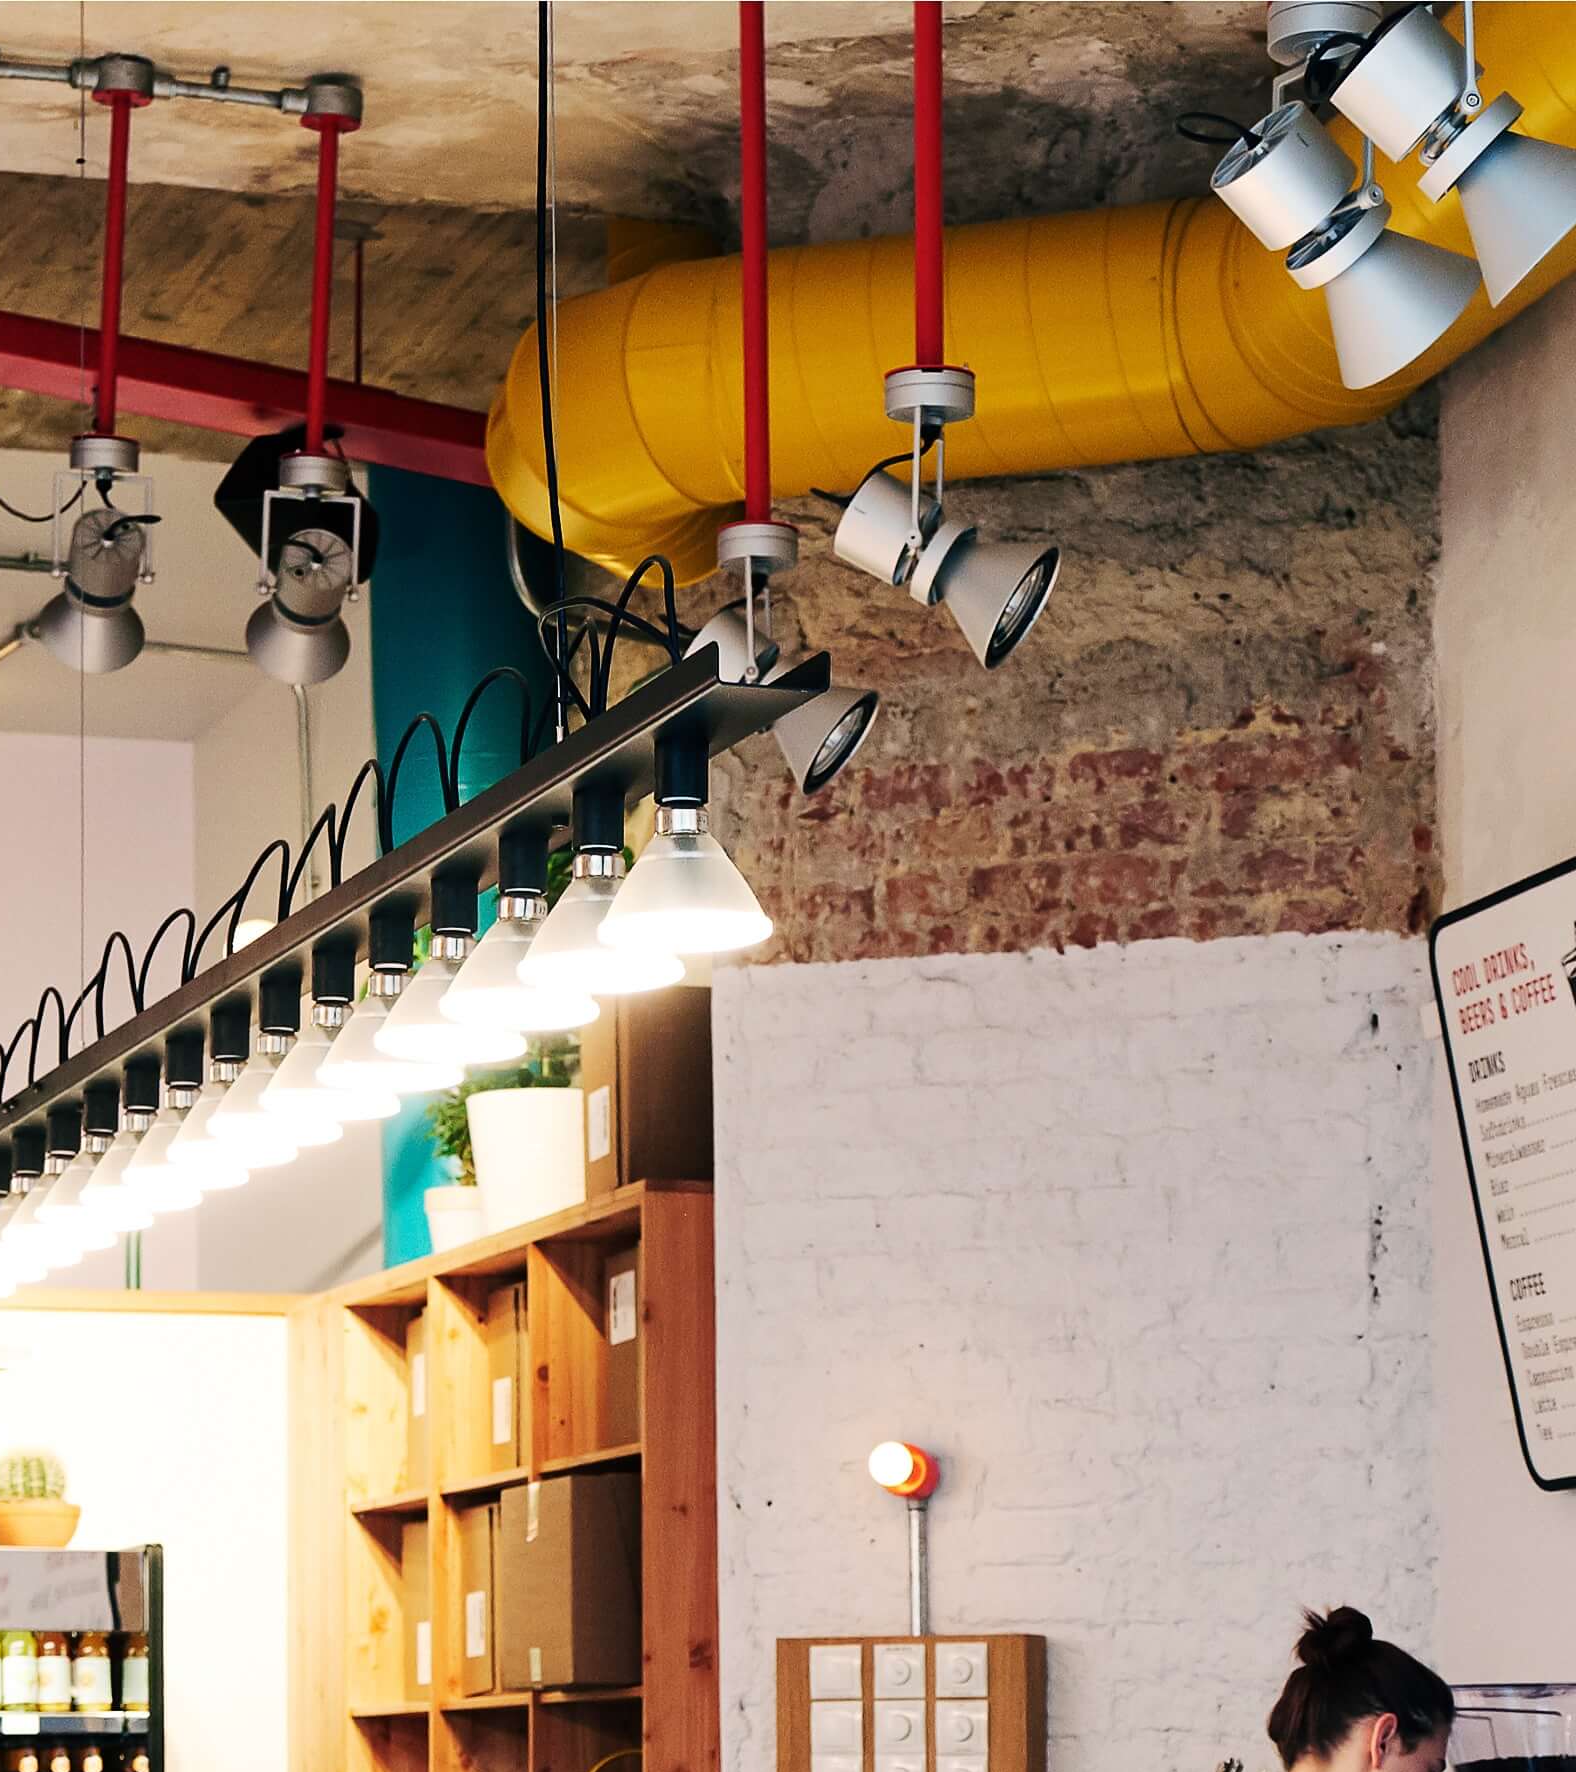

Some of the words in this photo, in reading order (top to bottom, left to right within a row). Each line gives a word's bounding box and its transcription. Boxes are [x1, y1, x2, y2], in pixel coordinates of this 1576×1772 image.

[1452, 962, 1481, 997] COOL
[1483, 942, 1535, 984] DRINKS,
[1459, 997, 1496, 1034] BEERS
[1498, 992, 1508, 1019] &
[1511, 973, 1556, 1014] COFFEE
[1468, 1050, 1506, 1082] DRINKS
[1510, 1272, 1547, 1301] COFFEE
